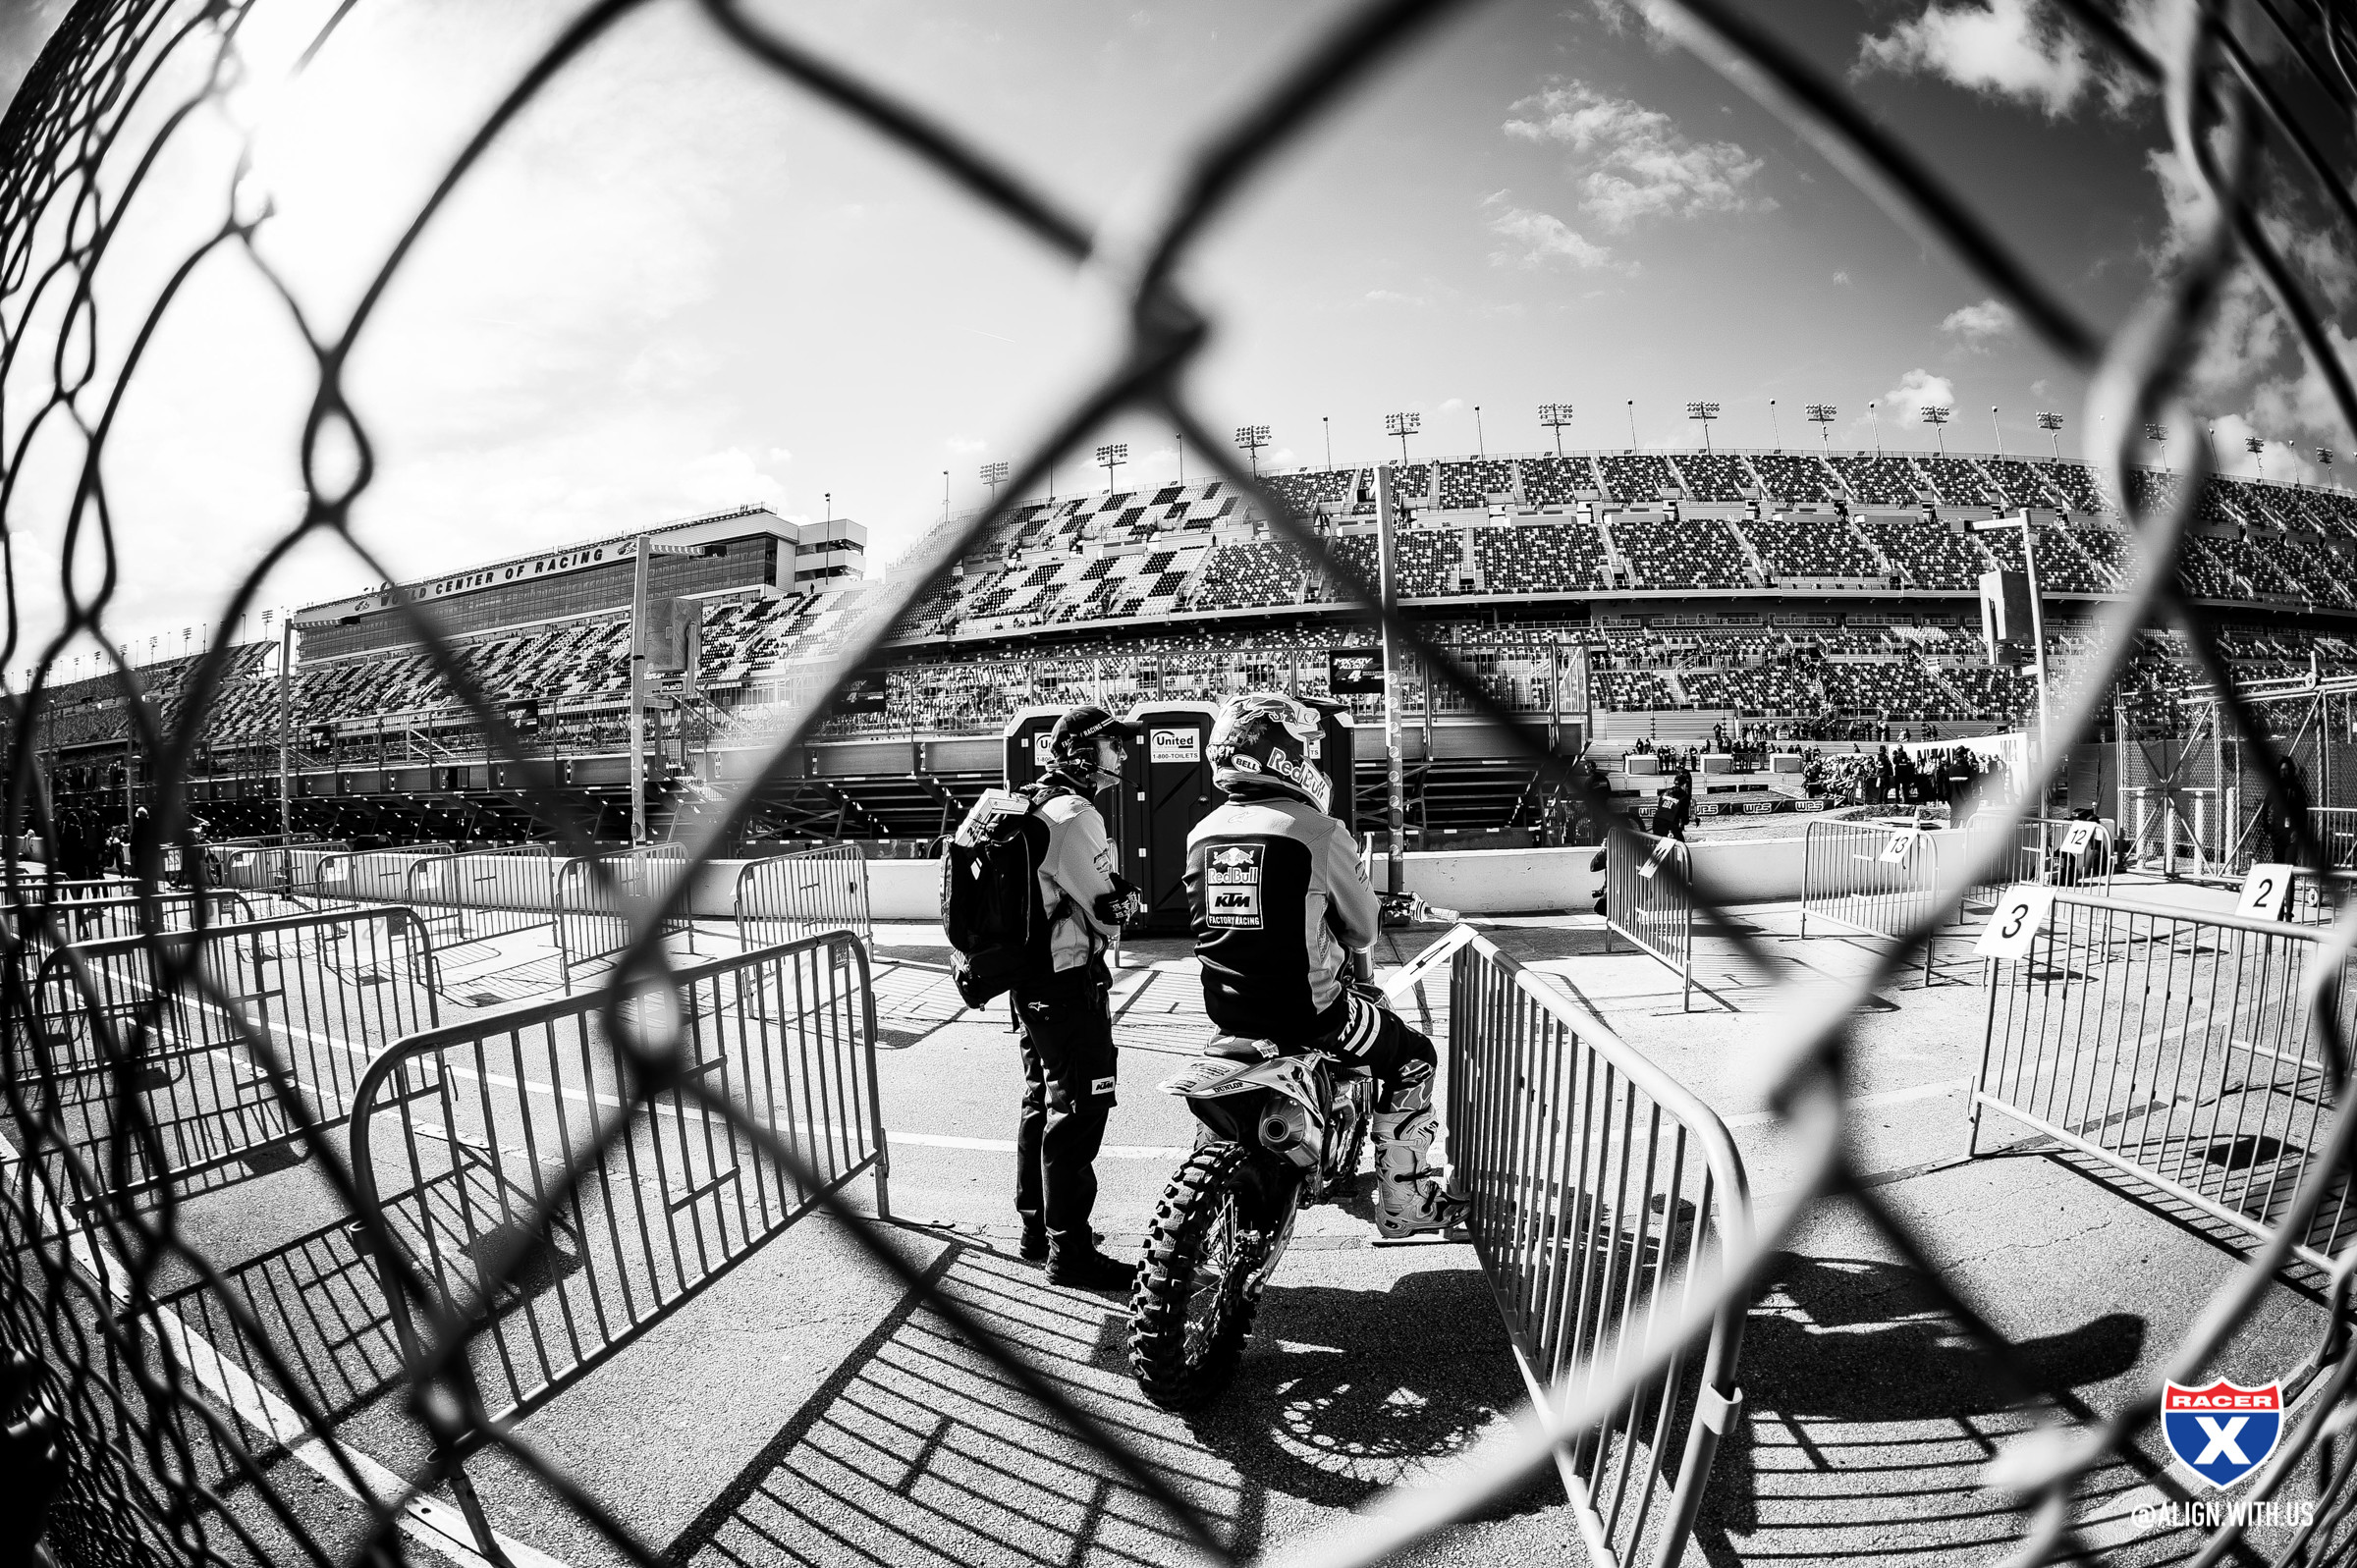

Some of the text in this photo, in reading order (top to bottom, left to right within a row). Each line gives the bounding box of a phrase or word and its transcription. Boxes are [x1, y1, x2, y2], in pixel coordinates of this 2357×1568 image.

[380, 549, 603, 607] WOLD CENTER OF RACING
[1083, 723, 1103, 737] RACING
[1156, 735, 1193, 746] United
[1236, 757, 1258, 771] BELL
[1638, 807, 1658, 817] WP
[1743, 802, 1772, 814] WPS
[1795, 800, 1824, 812] WPS
[2071, 829, 2087, 845] 12
[1891, 837, 1909, 853] 13
[1215, 892, 1250, 907] KTM
[2253, 879, 2273, 907] 2
[1209, 915, 1260, 925] FACTORY RACING
[2001, 903, 2029, 939] 3
[1213, 1081, 1244, 1093] DUNLOP
